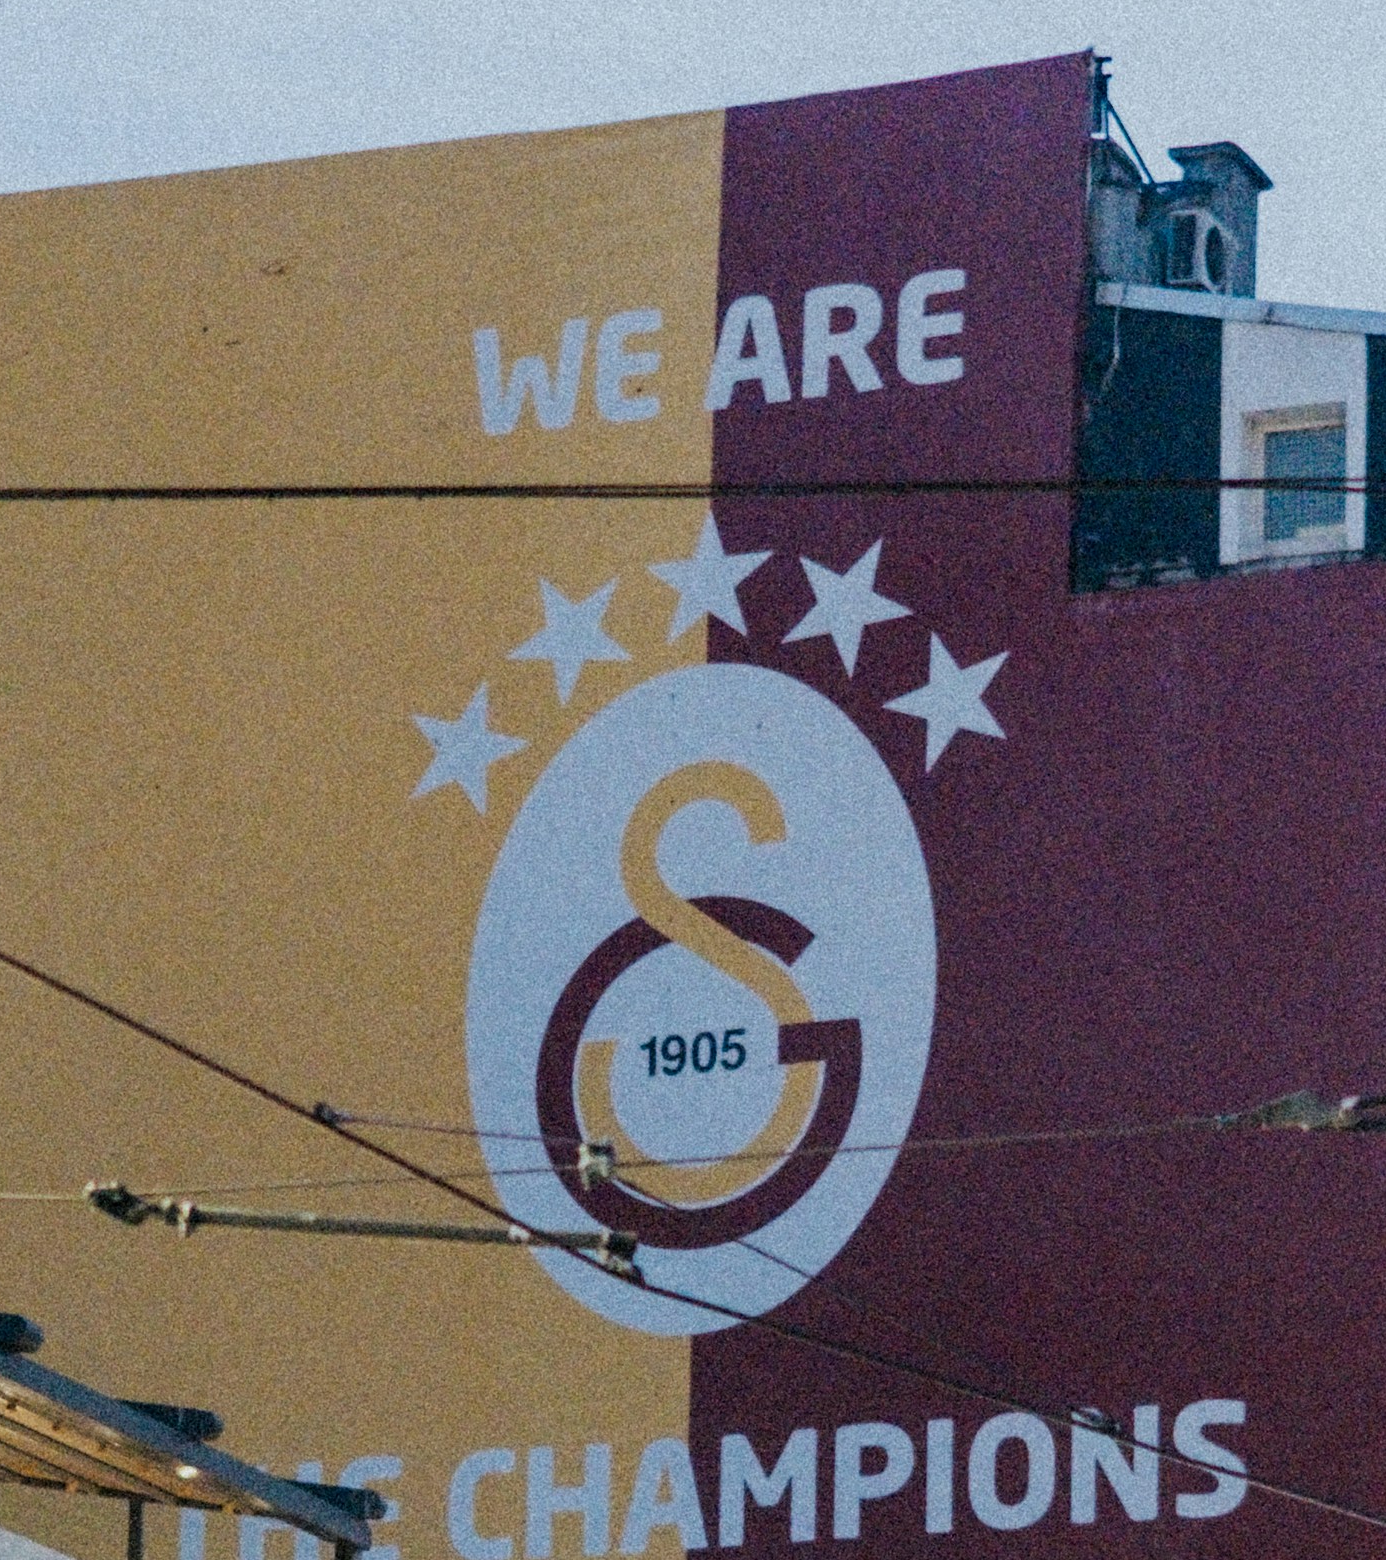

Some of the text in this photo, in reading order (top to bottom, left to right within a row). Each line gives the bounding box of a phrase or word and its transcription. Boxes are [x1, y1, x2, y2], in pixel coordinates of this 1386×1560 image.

[473, 268, 967, 436] WE ARE
[640, 1027, 747, 1078] 1905
